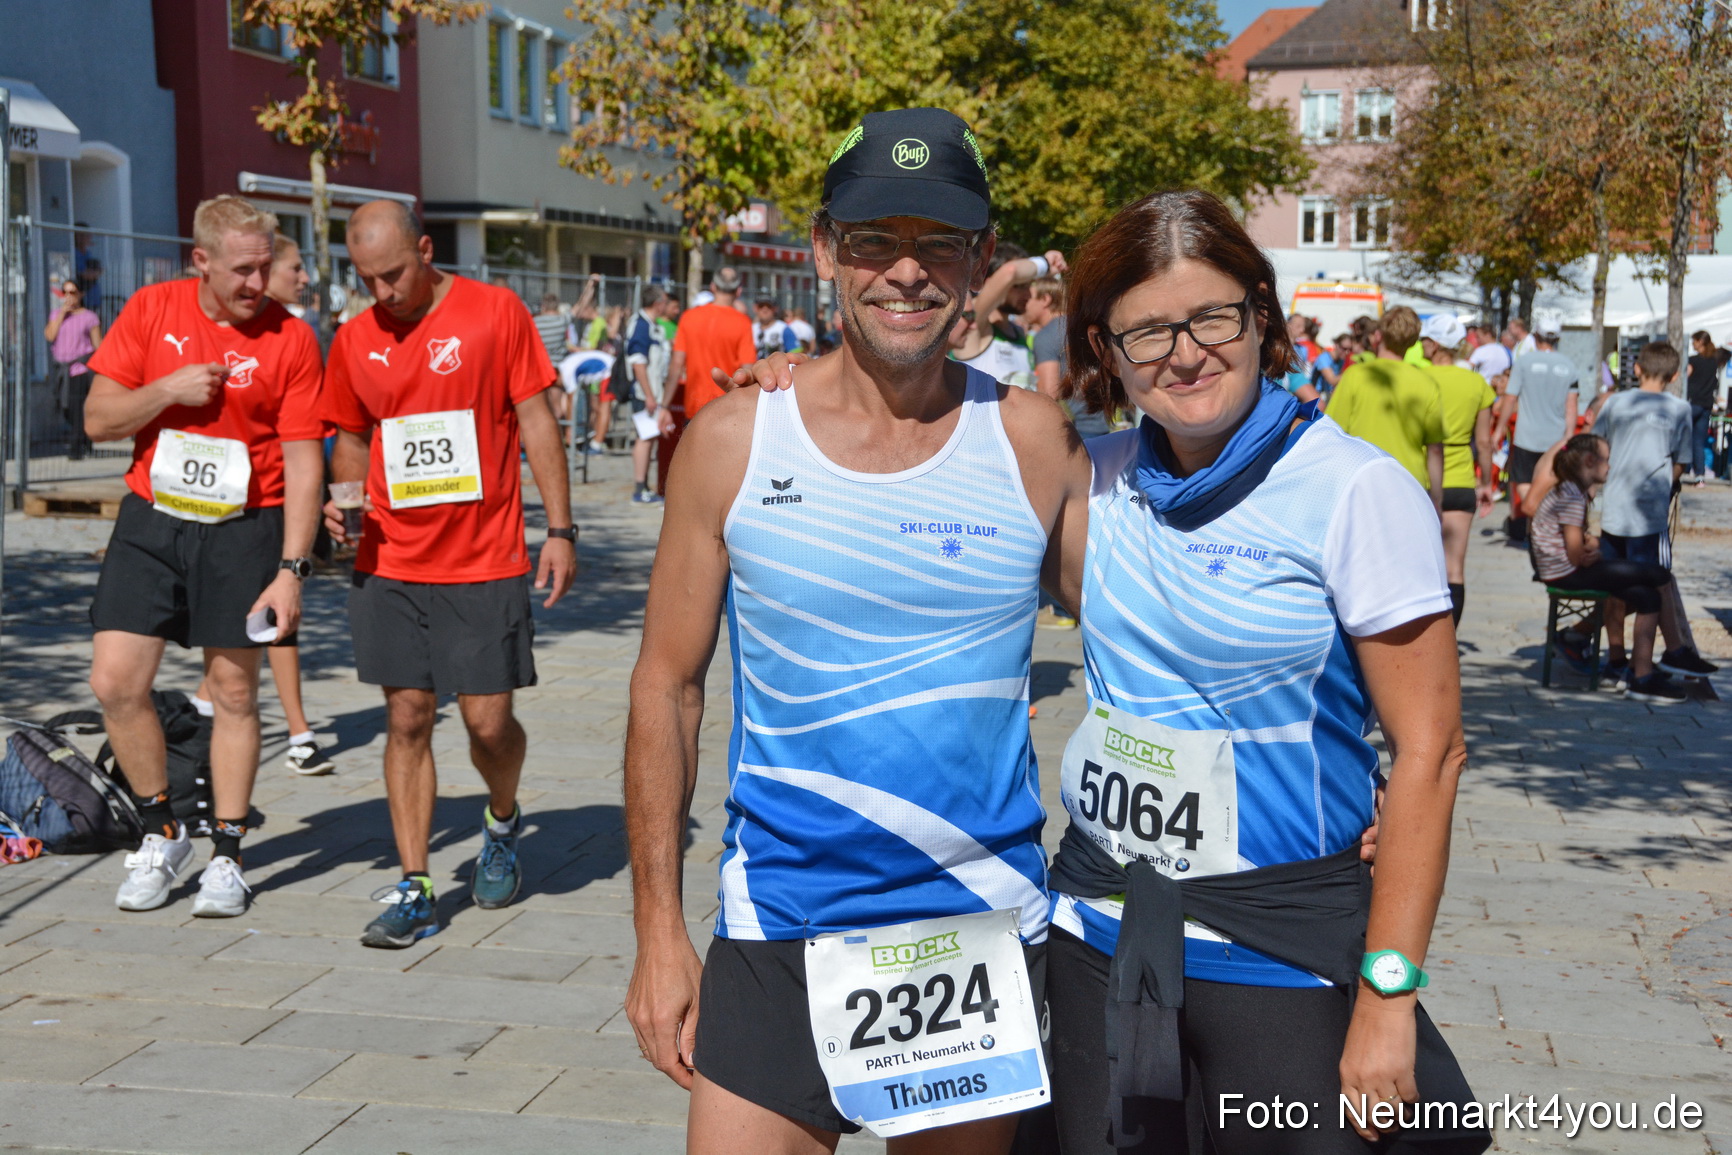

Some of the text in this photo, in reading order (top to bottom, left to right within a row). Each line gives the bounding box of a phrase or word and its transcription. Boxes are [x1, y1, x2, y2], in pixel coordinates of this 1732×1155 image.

[897, 144, 926, 164] Buff
[404, 438, 454, 468] 253
[182, 459, 217, 488] 96
[405, 481, 461, 496] Alexander
[762, 493, 803, 506] erima
[171, 498, 222, 515] Christian
[899, 522, 998, 538] SKI-CLUB LAUF
[1185, 543, 1270, 562] SKI-CLUB LAUF
[1104, 726, 1176, 771] BOCK
[1103, 748, 1177, 778] inspired by smart concepts
[1079, 759, 1204, 851] 5064
[1089, 831, 1114, 853] PARTL
[871, 931, 961, 967] BOCK
[873, 951, 963, 975] inspired by smart concepts
[845, 962, 1000, 1051] 2324
[828, 1041, 836, 1053] D
[865, 1040, 976, 1071] PARTL Neumarkt
[884, 1072, 988, 1110] Thomas
